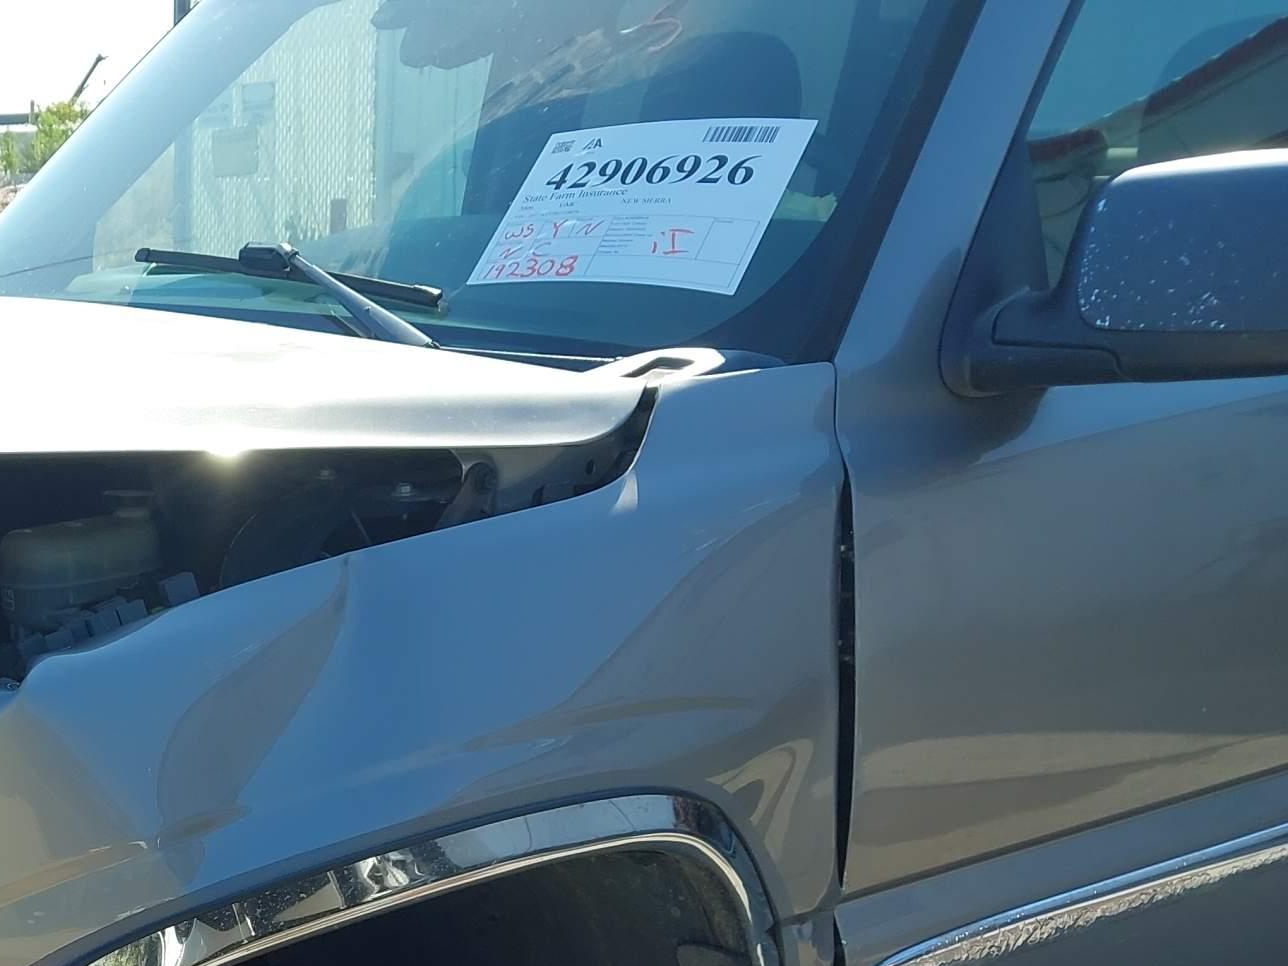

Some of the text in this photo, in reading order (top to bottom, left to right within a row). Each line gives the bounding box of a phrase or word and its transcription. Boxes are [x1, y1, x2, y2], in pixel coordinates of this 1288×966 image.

[546, 154, 763, 190] 42906926
[523, 187, 628, 204] State Farm Insurance
[483, 255, 579, 279] 192308
